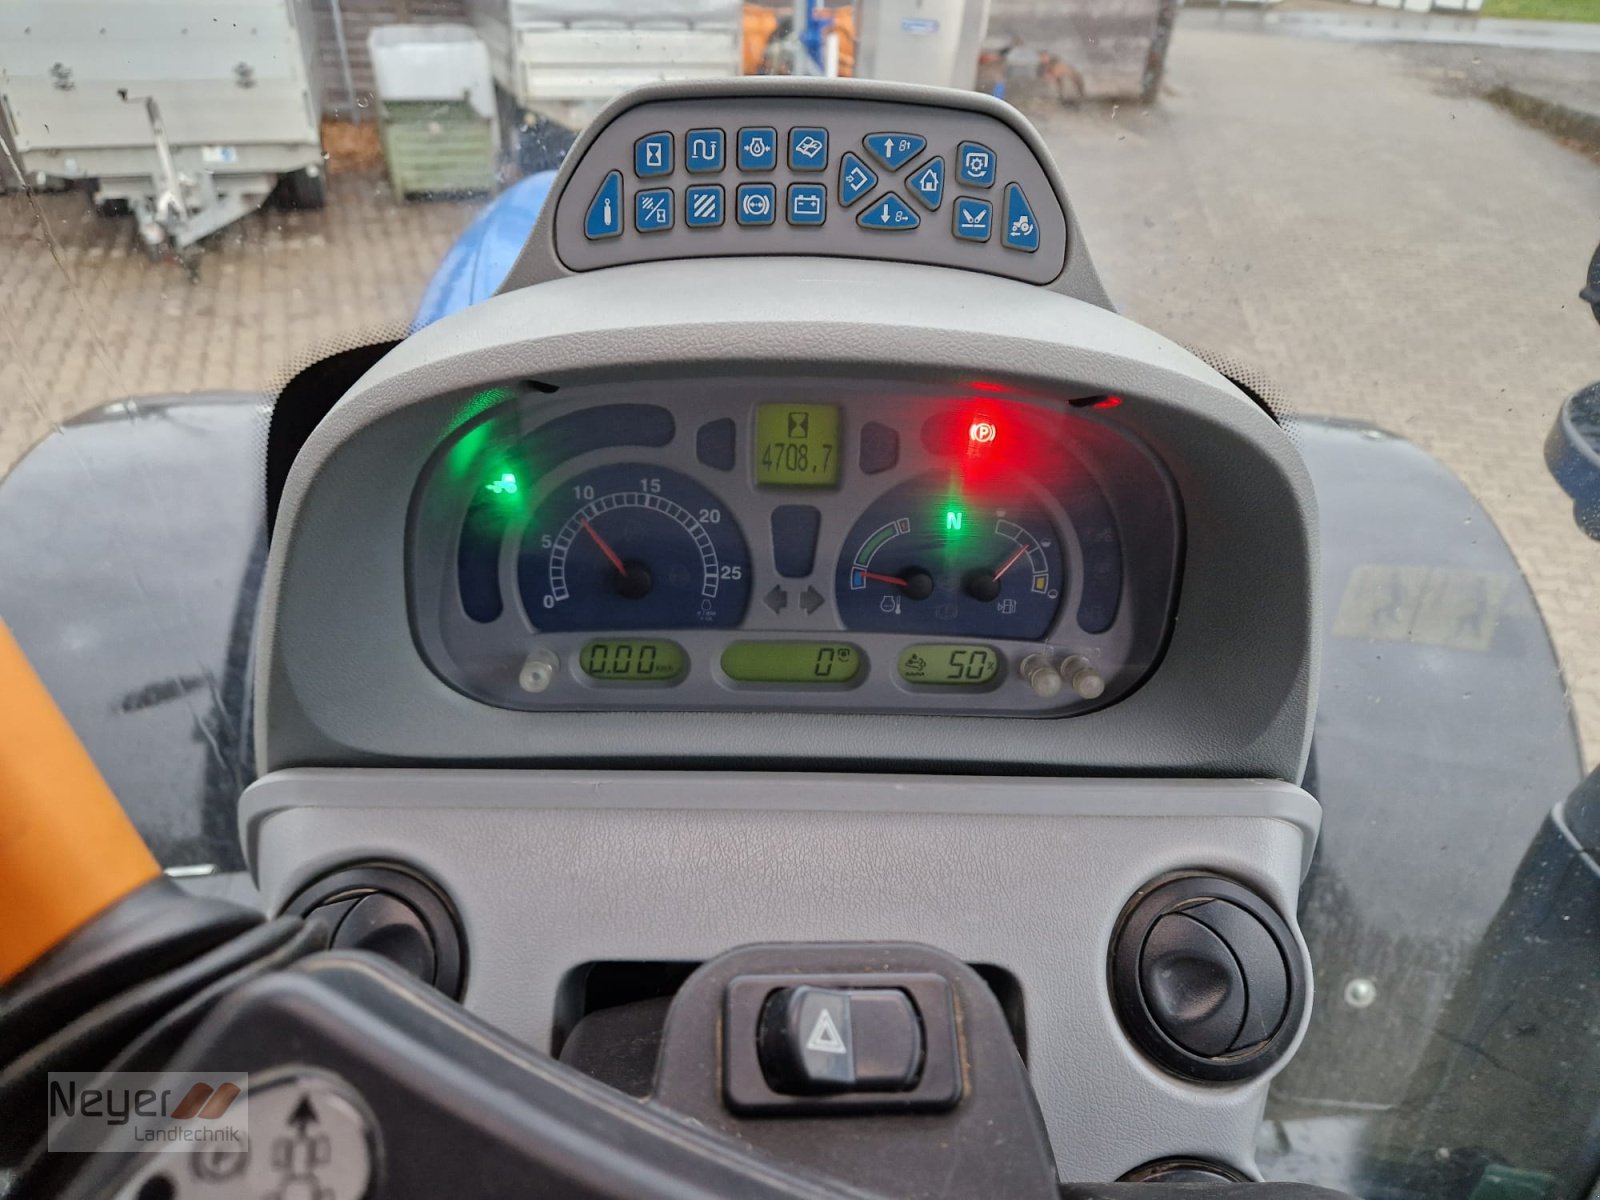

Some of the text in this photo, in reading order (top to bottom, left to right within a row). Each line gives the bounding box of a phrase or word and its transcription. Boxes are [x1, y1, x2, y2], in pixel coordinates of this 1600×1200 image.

[574, 486, 594, 500] 10
[641, 479, 661, 493] 15
[700, 509, 720, 523] 20
[946, 511, 962, 529] N
[542, 535, 551, 549] 5
[721, 567, 742, 580] 25
[543, 596, 554, 609] 0
[590, 645, 656, 674] 0.00
[814, 648, 834, 676] 0
[948, 651, 987, 679] 50
